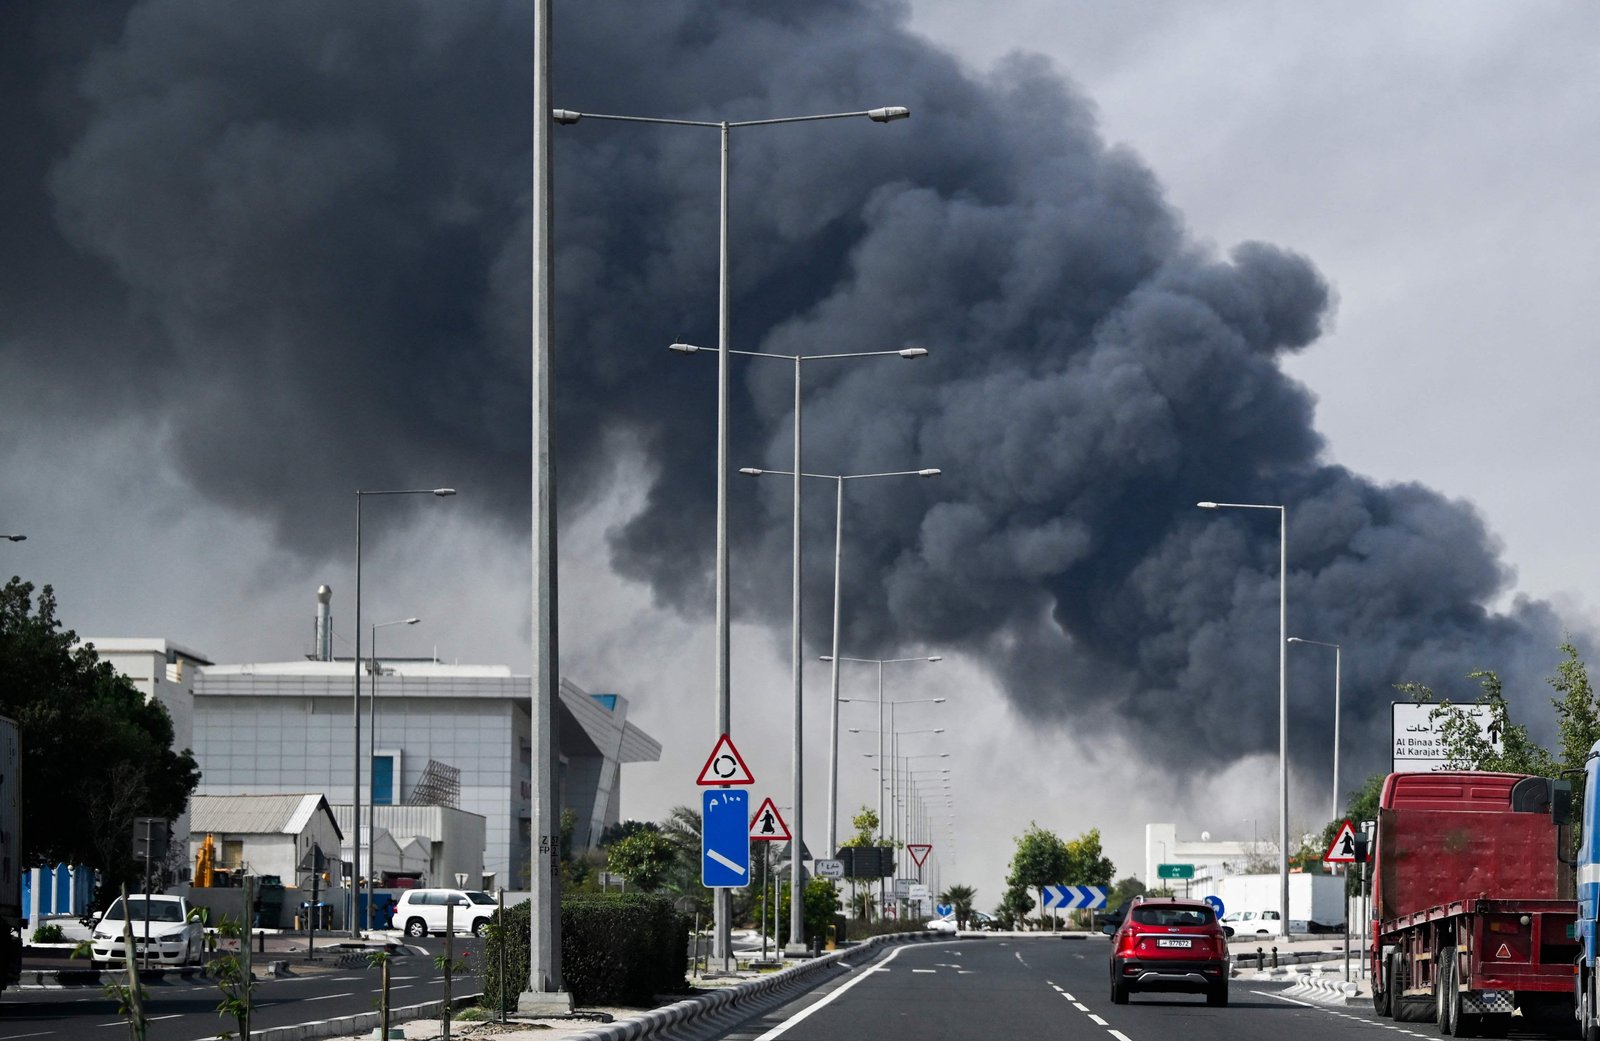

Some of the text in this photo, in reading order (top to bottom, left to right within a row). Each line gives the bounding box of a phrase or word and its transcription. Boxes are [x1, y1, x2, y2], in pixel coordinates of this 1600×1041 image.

[1396, 738, 1405, 746] Al
[1408, 738, 1433, 746] Binaa
[1396, 747, 1405, 755] Al
[1408, 747, 1439, 757] Karajat
[709, 793, 741, 812] ١٠٠ م
